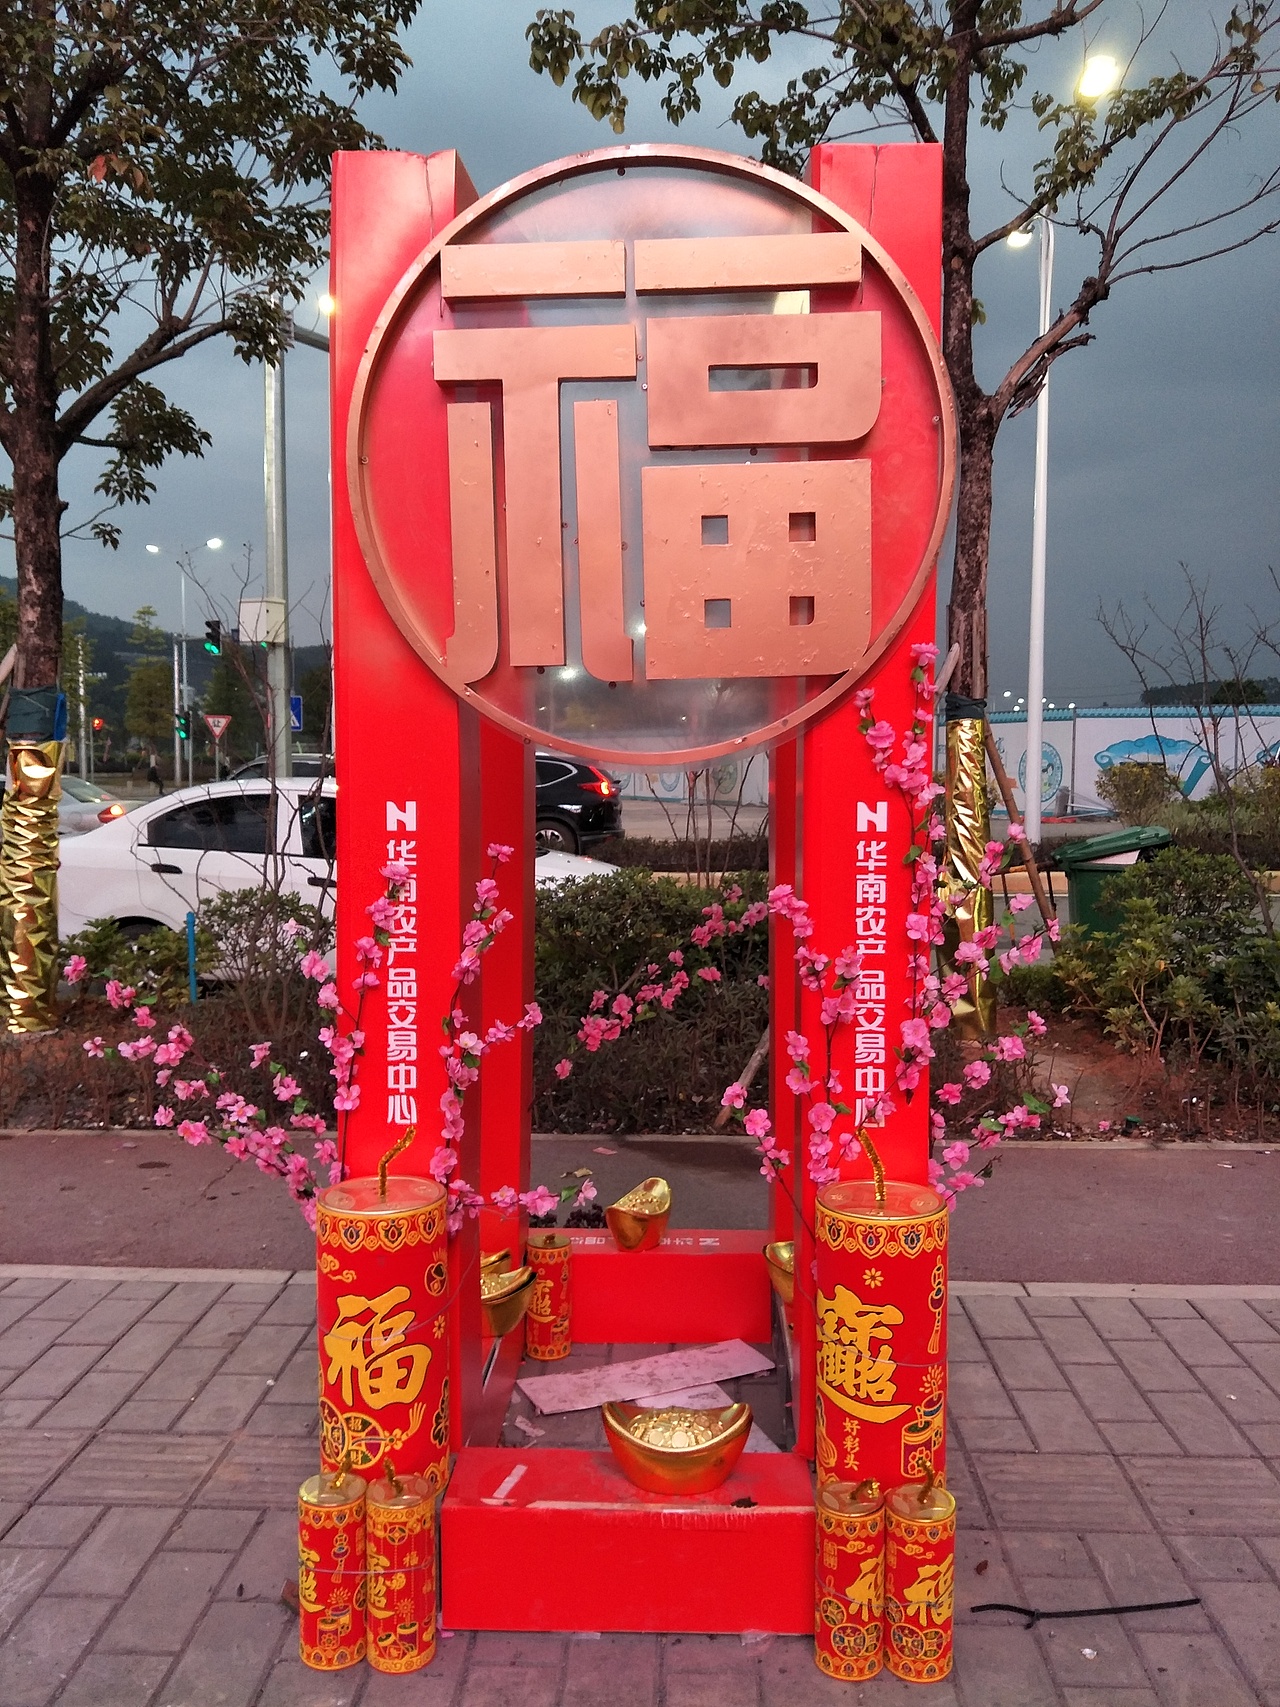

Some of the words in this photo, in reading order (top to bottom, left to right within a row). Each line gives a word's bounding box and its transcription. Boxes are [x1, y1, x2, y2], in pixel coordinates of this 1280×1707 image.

[433, 232, 882, 683] 福
[386, 801, 417, 831] N
[856, 802, 888, 832] N
[323, 1285, 432, 1410] 福
[842, 1417, 862, 1471] 好彩头
